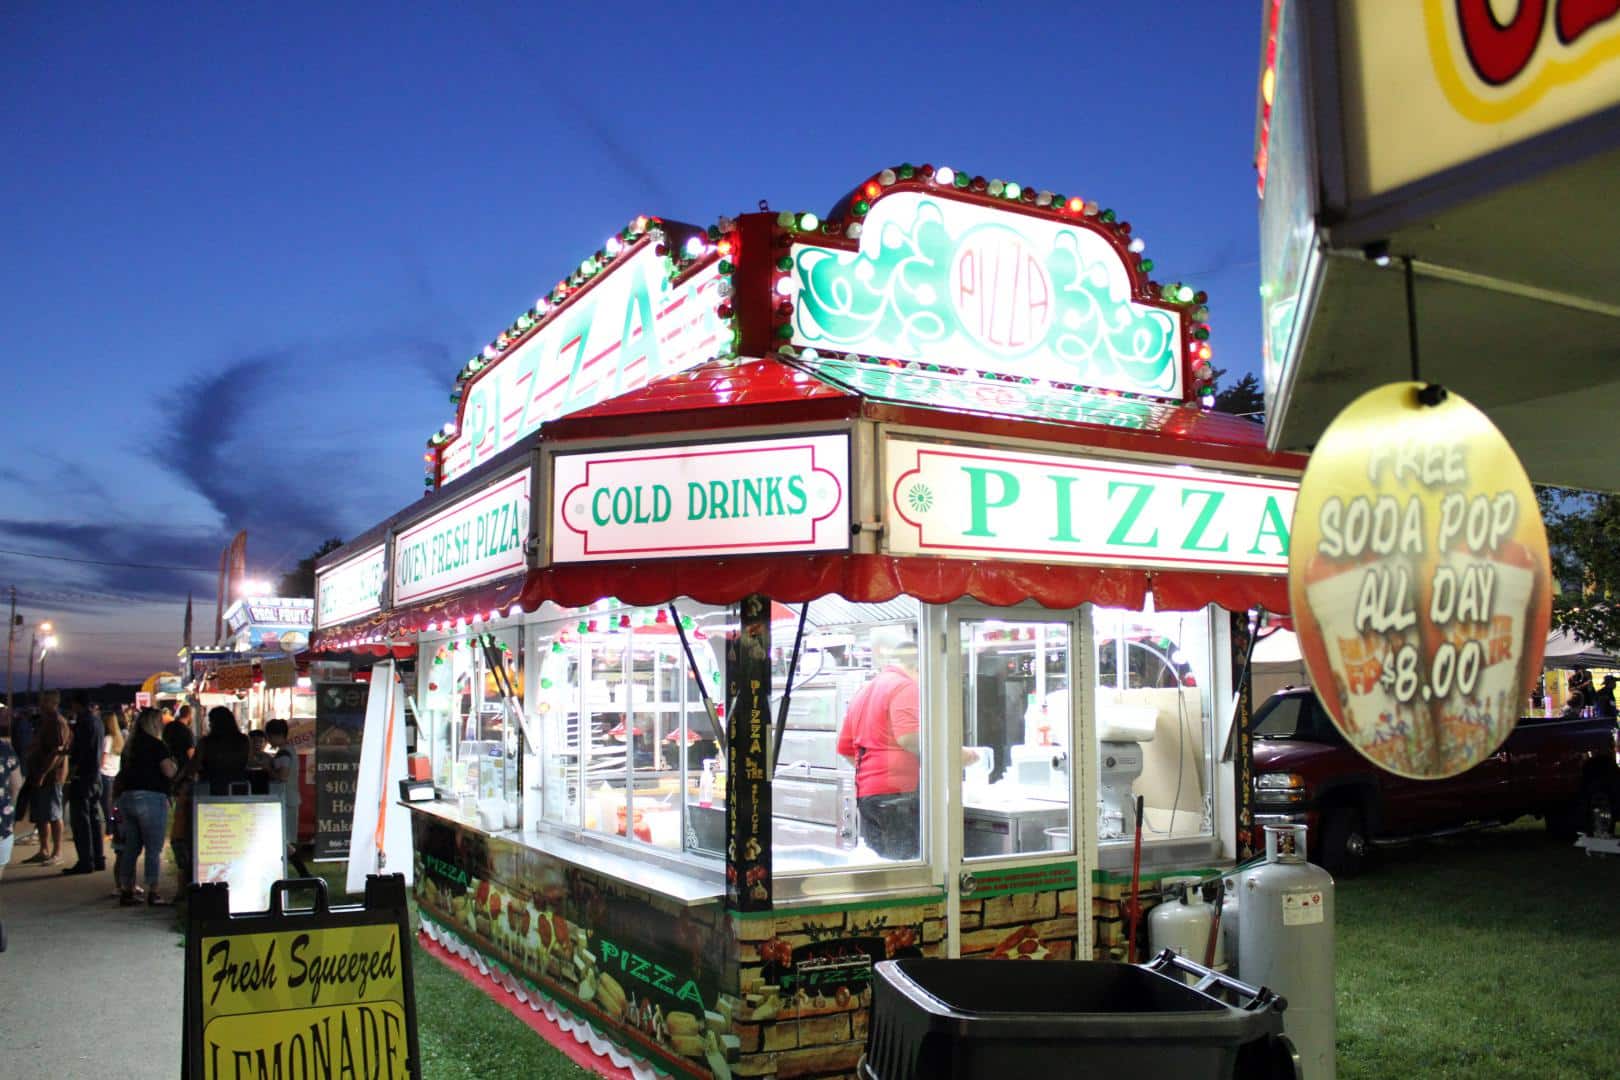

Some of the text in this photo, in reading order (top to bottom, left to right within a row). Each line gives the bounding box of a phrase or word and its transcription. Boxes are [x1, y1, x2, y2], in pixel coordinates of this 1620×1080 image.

[959, 242, 1049, 347] PIZZA
[1367, 442, 1470, 488] FREE
[592, 475, 808, 526] COLD DRINKS
[961, 466, 1291, 557] PIZZA
[1318, 493, 1518, 558] SODA POP
[401, 541, 427, 586] OVEN
[431, 521, 471, 577] FRESH
[476, 500, 521, 559] PIZZA
[1355, 564, 1497, 633] ALL DAY
[1379, 640, 1482, 703] $8.00
[750, 679, 762, 753] PIZZA
[318, 762, 349, 772] ENTER
[332, 799, 354, 814] Ho
[425, 855, 469, 886] PIZZA
[207, 932, 396, 1005] Fresh Squeezed
[600, 938, 706, 1010] PIZZA
